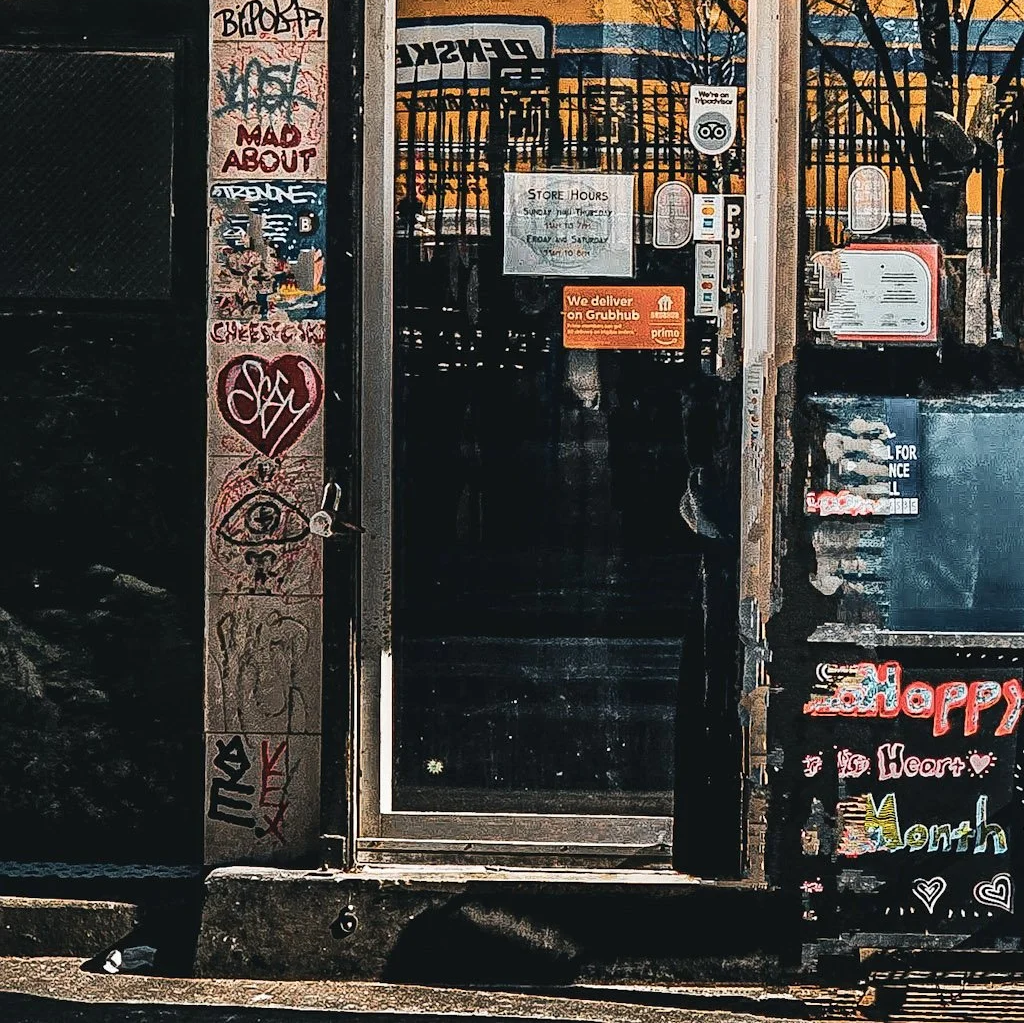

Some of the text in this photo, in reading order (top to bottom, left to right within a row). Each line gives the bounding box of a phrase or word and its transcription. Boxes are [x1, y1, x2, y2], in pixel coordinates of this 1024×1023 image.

[236, 123, 302, 149] MAD
[221, 147, 317, 174] ABOUT
[566, 295, 634, 307] We deliver
[566, 311, 583, 321] on
[585, 309, 641, 321] Grubhub
[895, 444, 918, 461] FOR
[877, 742, 967, 782] Heart
[862, 792, 1009, 855] Month
